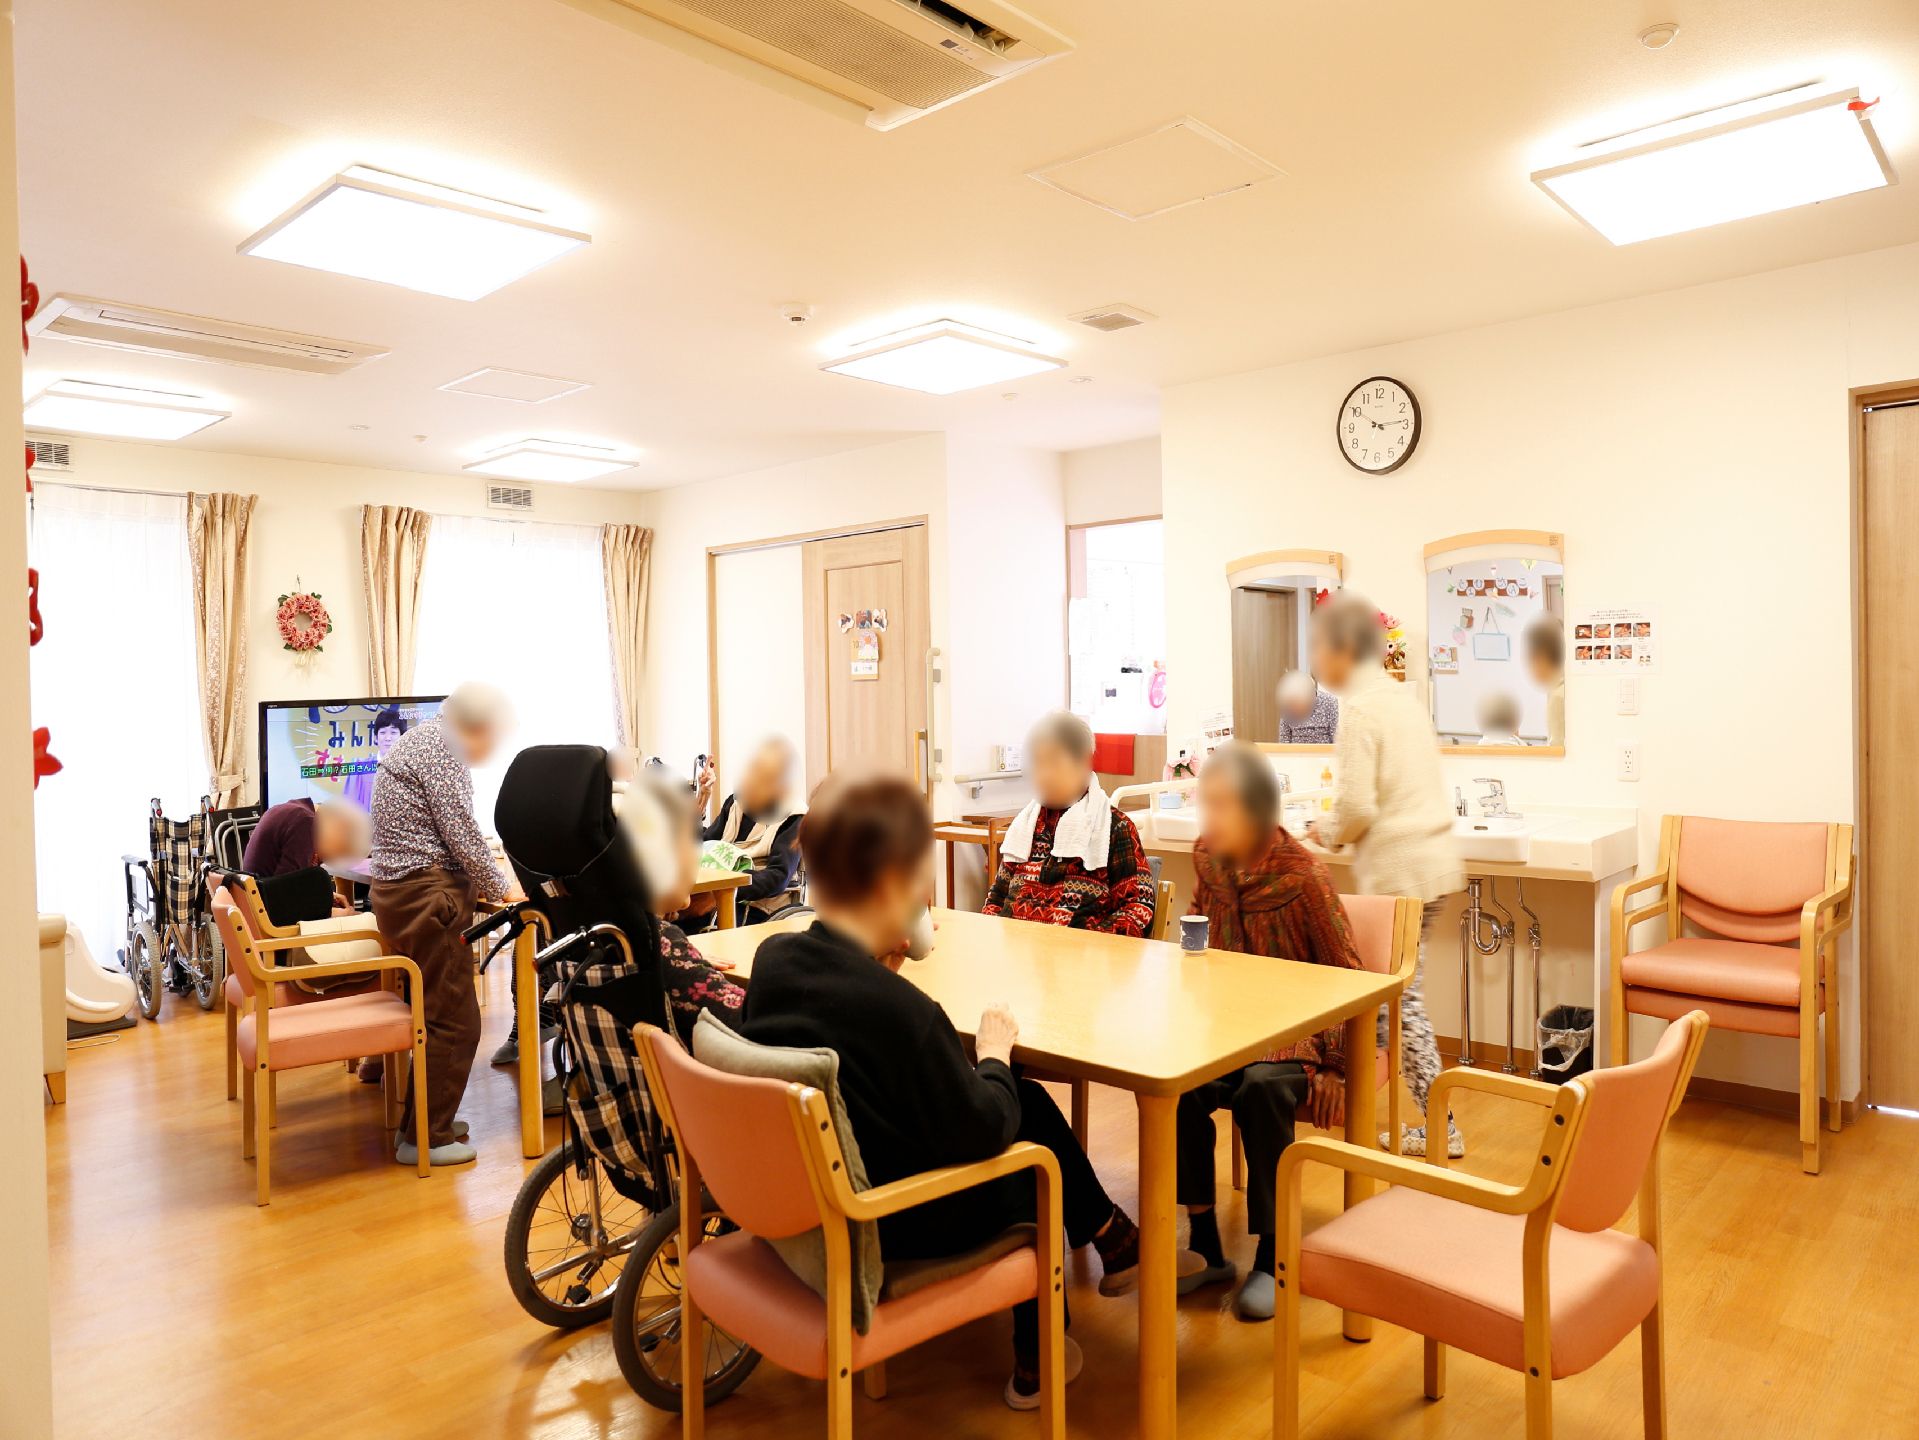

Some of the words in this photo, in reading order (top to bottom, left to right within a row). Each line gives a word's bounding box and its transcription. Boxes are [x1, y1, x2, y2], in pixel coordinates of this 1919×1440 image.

[1362, 393, 1370, 404] 11
[1375, 388, 1385, 399] 12
[1352, 406, 1361, 417] 10
[1399, 402, 1406, 413] 2
[1348, 422, 1355, 433] 9
[1402, 419, 1409, 430] 3
[1352, 438, 1359, 449] 8
[1397, 435, 1404, 446] 4
[1362, 448, 1368, 460] 7
[1373, 452, 1380, 463] 6
[1388, 448, 1394, 458] 5
